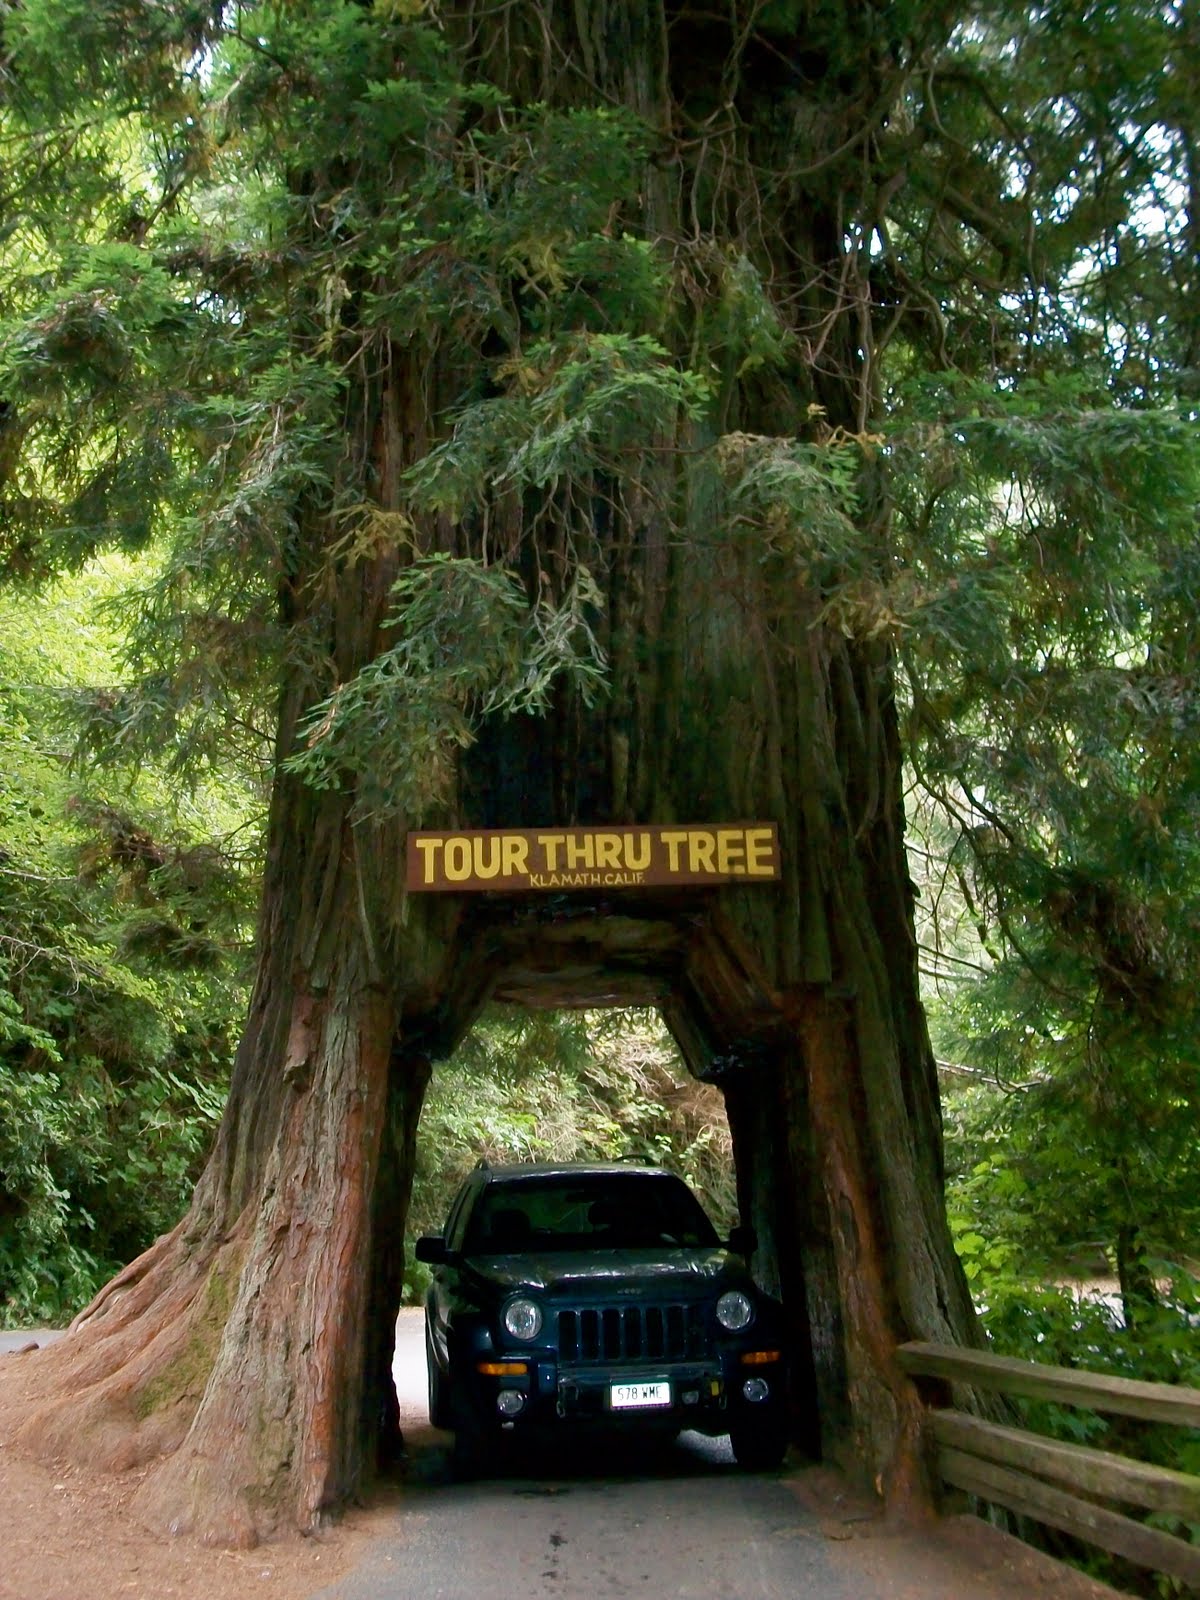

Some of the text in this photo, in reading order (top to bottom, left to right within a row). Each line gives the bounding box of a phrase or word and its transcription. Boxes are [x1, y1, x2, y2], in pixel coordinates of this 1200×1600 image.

[416, 829, 775, 883] TOUR THRU TREE
